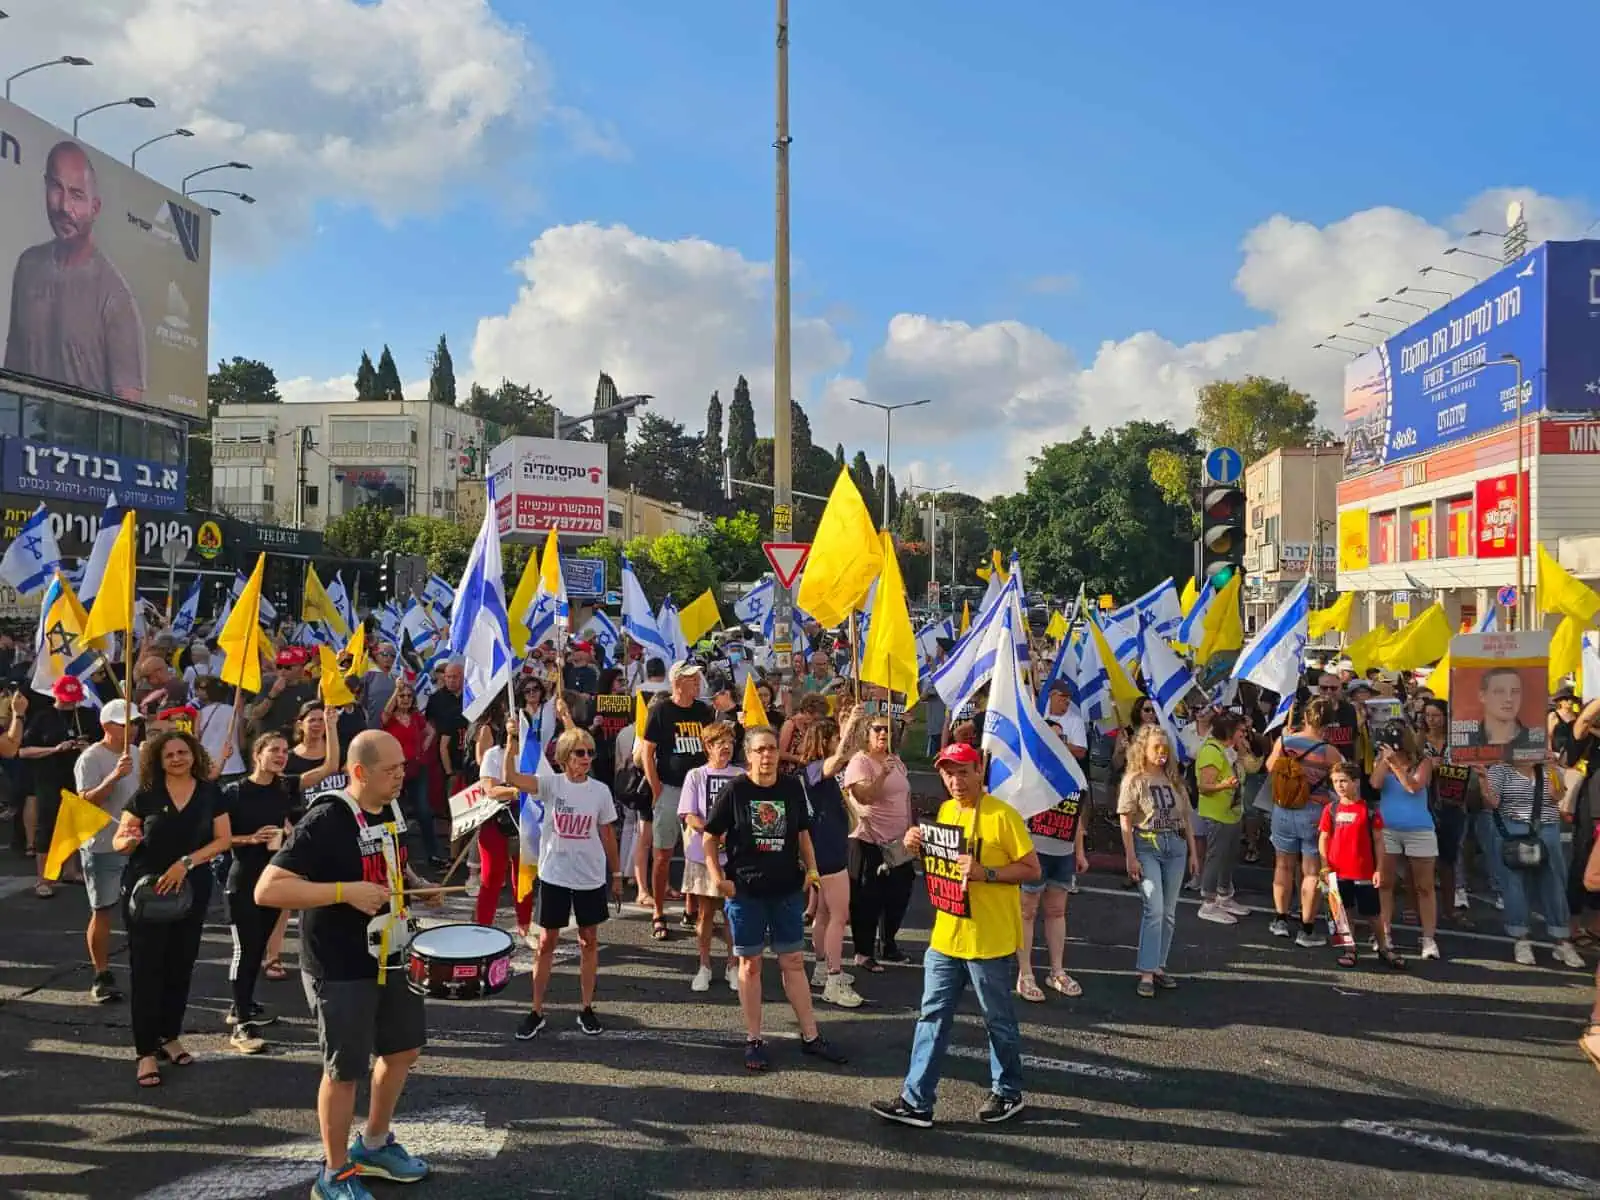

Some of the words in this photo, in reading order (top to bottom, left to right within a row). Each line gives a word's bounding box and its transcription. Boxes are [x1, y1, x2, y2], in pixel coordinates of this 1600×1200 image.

[135, 464, 179, 490] א.ב
[523, 461, 587, 480] טקסימדיה
[559, 502, 602, 516] התקשרו
[925, 855, 963, 881] 17.8.25
